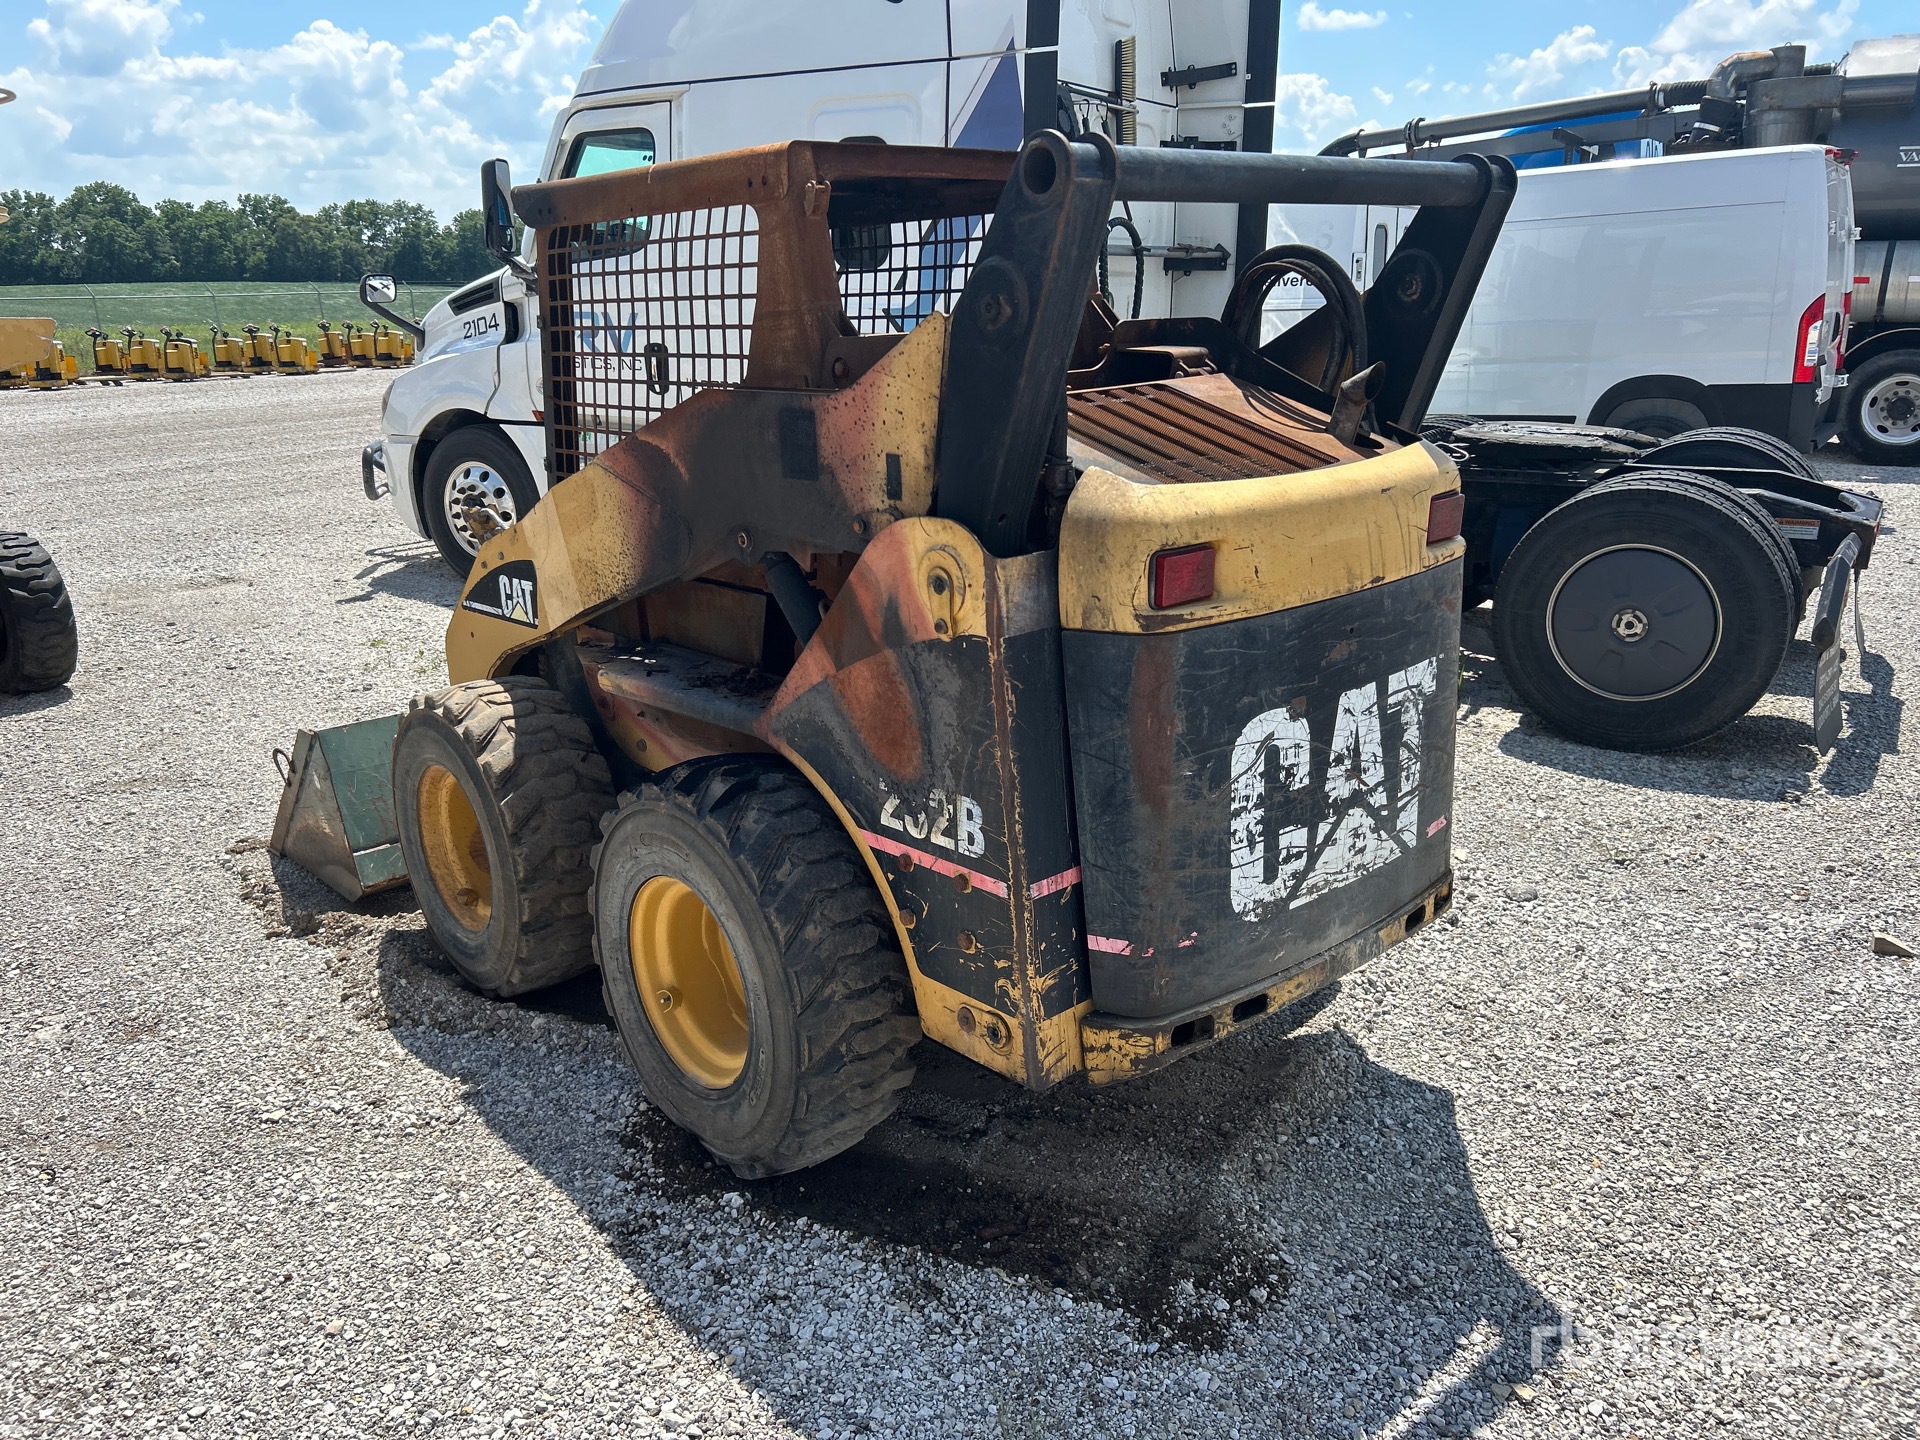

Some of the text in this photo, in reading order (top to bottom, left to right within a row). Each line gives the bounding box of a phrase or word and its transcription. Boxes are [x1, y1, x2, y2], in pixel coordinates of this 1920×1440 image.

[463, 312, 500, 340] 2104
[498, 574, 534, 625] CAT
[1230, 655, 1440, 922] CAT
